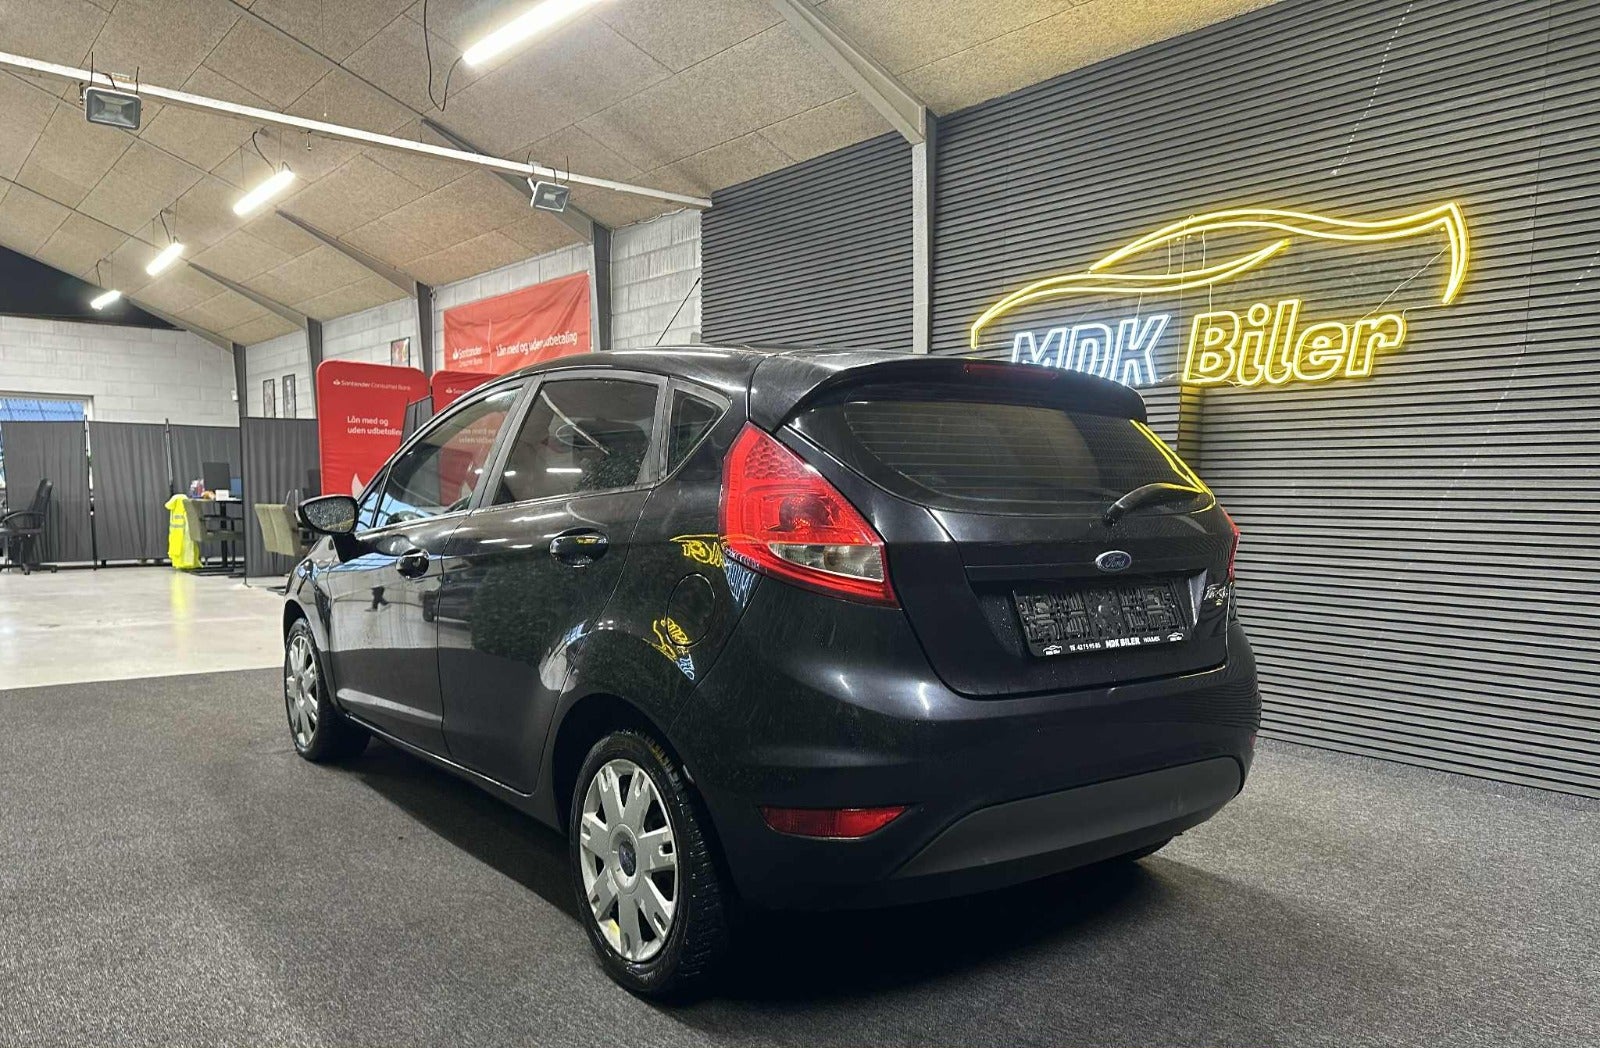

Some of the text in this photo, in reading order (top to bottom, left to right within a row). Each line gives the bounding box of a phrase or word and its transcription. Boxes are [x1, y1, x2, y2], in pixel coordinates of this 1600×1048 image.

[520, 342, 529, 355] og
[1011, 299, 1407, 387] MDK Biler
[458, 346, 482, 359] Santander
[341, 380, 370, 388] Santander
[371, 382, 397, 390] Consumer
[347, 415, 389, 427] Lån med og
[347, 426, 366, 434] uden
[1103, 553, 1127, 569] Ford
[1105, 638, 1120, 648] MDK
[1120, 637, 1141, 647] BILER
